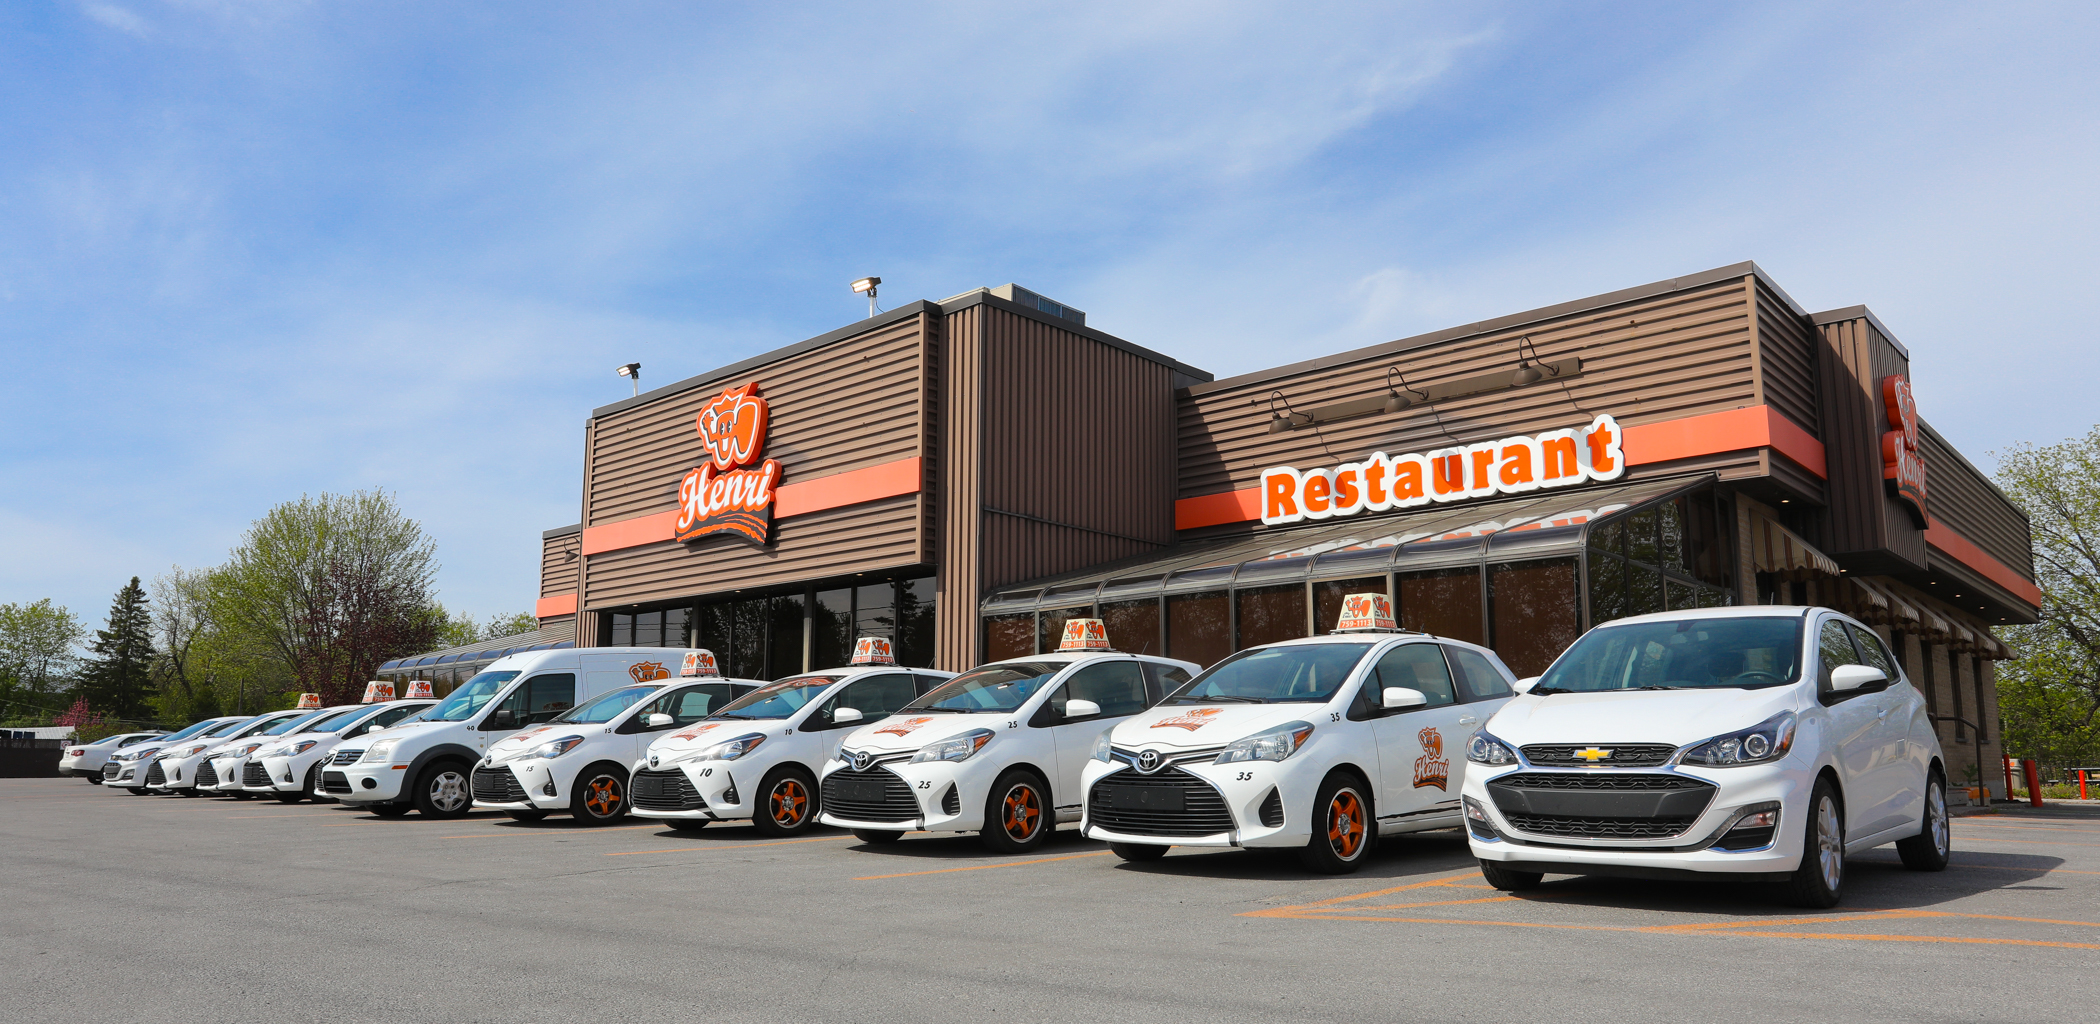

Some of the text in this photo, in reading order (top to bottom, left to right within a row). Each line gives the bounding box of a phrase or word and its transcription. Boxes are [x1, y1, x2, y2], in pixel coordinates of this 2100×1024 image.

[1265, 422, 1615, 519] Restaurant
[1894, 435, 1927, 496] Henri
[678, 462, 770, 529] Henri
[1341, 620, 1371, 628] 759-1113
[1376, 619, 1397, 628] 759-1113
[1087, 640, 1108, 648] 759-1113
[1330, 712, 1340, 723] 35
[1008, 721, 1018, 729] 25
[784, 728, 793, 736] 10
[700, 767, 713, 777] 10
[1414, 755, 1449, 784] Henri
[1236, 771, 1253, 781] 35
[918, 780, 931, 789] 25
